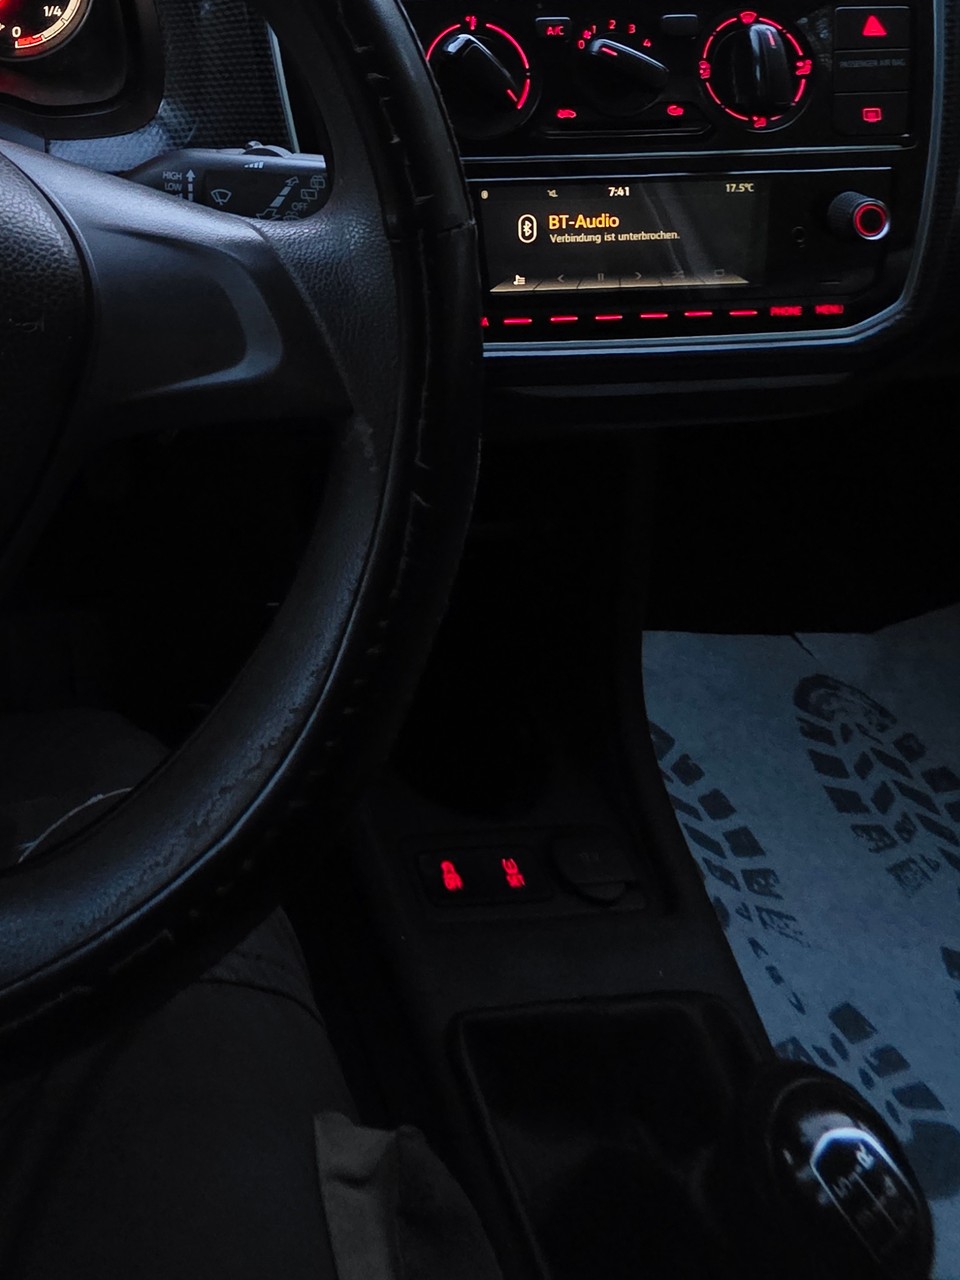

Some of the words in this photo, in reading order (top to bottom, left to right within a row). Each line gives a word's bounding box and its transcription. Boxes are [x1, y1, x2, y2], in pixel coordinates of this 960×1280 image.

[43, 5, 62, 17] 1/4
[608, 19, 617, 30] 2
[628, 23, 636, 34] 3
[11, 26, 22, 38] 0
[546, 25, 565, 36] A/C
[577, 39, 585, 50] 0
[642, 38, 652, 48] 4
[162, 170, 183, 181] HIGH
[164, 182, 183, 192] LOW
[608, 186, 630, 198] 7:41
[725, 182, 755, 193] 17.5°C
[291, 201, 309, 212] OFF
[548, 212, 620, 230] BT-Audio
[550, 232, 601, 245] Verbindung
[604, 231, 616, 242] ist
[618, 230, 680, 242] unterbrochen.
